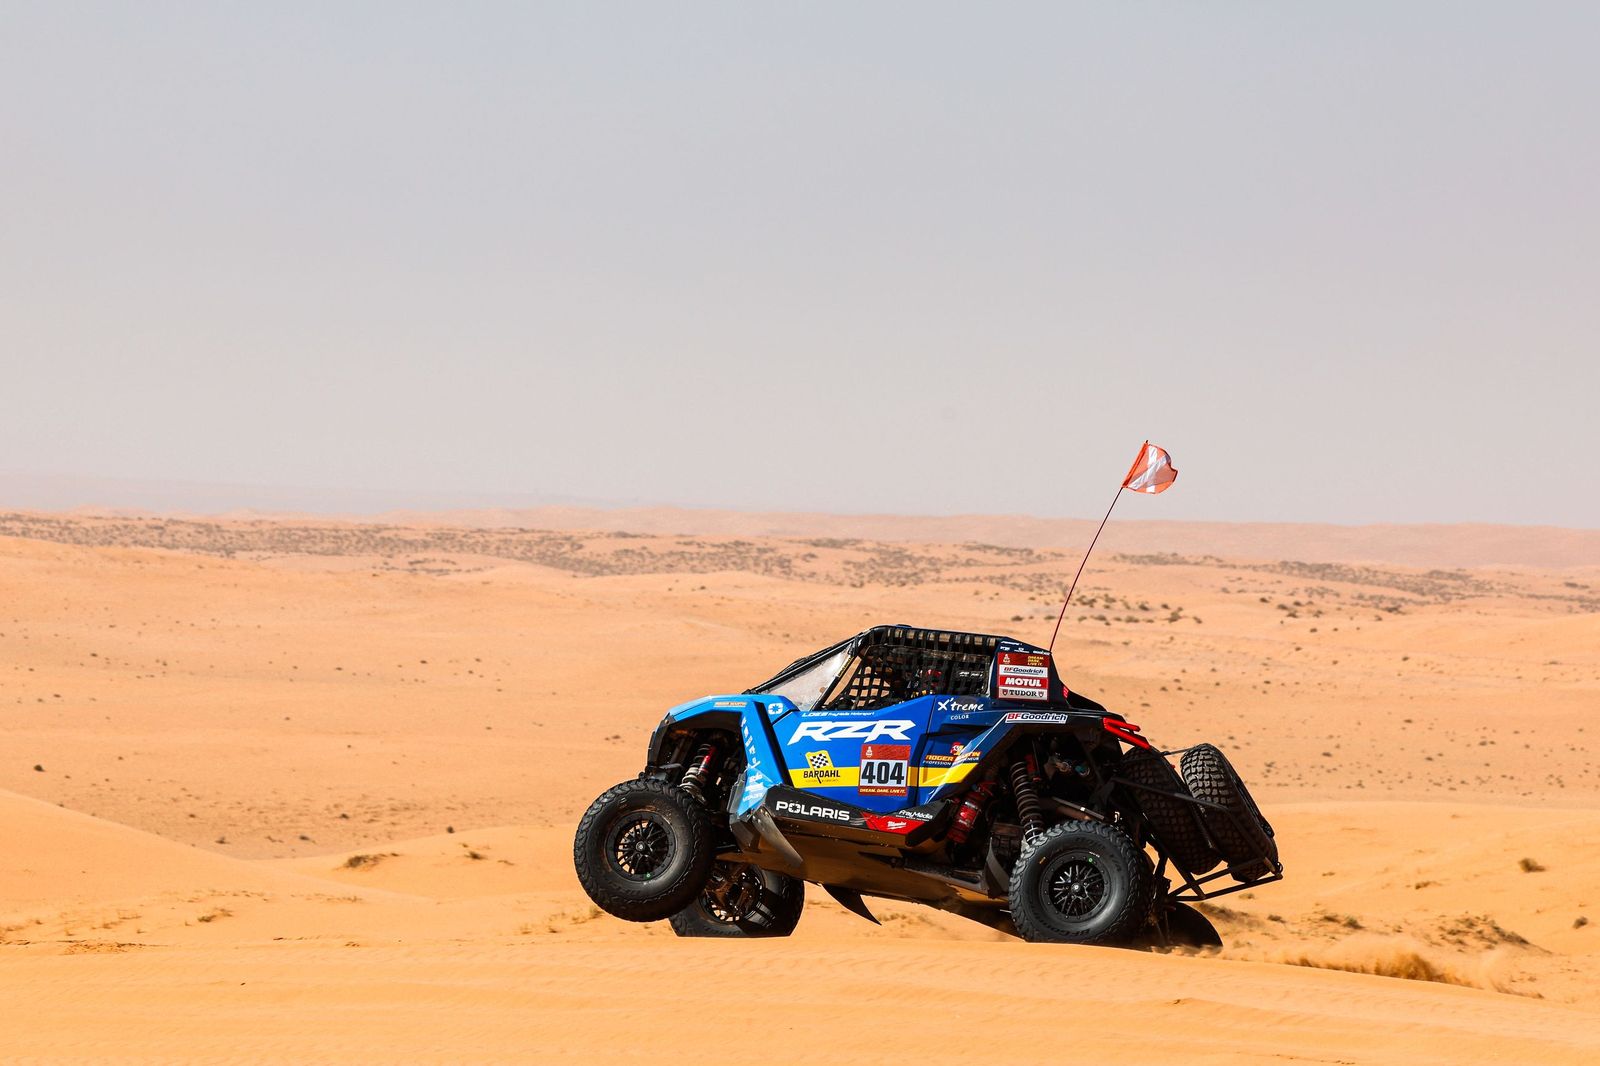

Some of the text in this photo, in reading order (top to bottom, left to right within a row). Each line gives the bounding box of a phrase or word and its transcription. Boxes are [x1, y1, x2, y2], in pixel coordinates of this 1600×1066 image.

[1005, 677, 1041, 687] MOTUL
[937, 697, 984, 712] X'treme
[1007, 712, 1067, 721] BFGoodrich
[787, 720, 916, 746] RZR
[925, 754, 954, 762] ROGER
[803, 769, 841, 779] BARDAHL
[861, 761, 904, 784] 404
[775, 801, 850, 821] POLARIS
